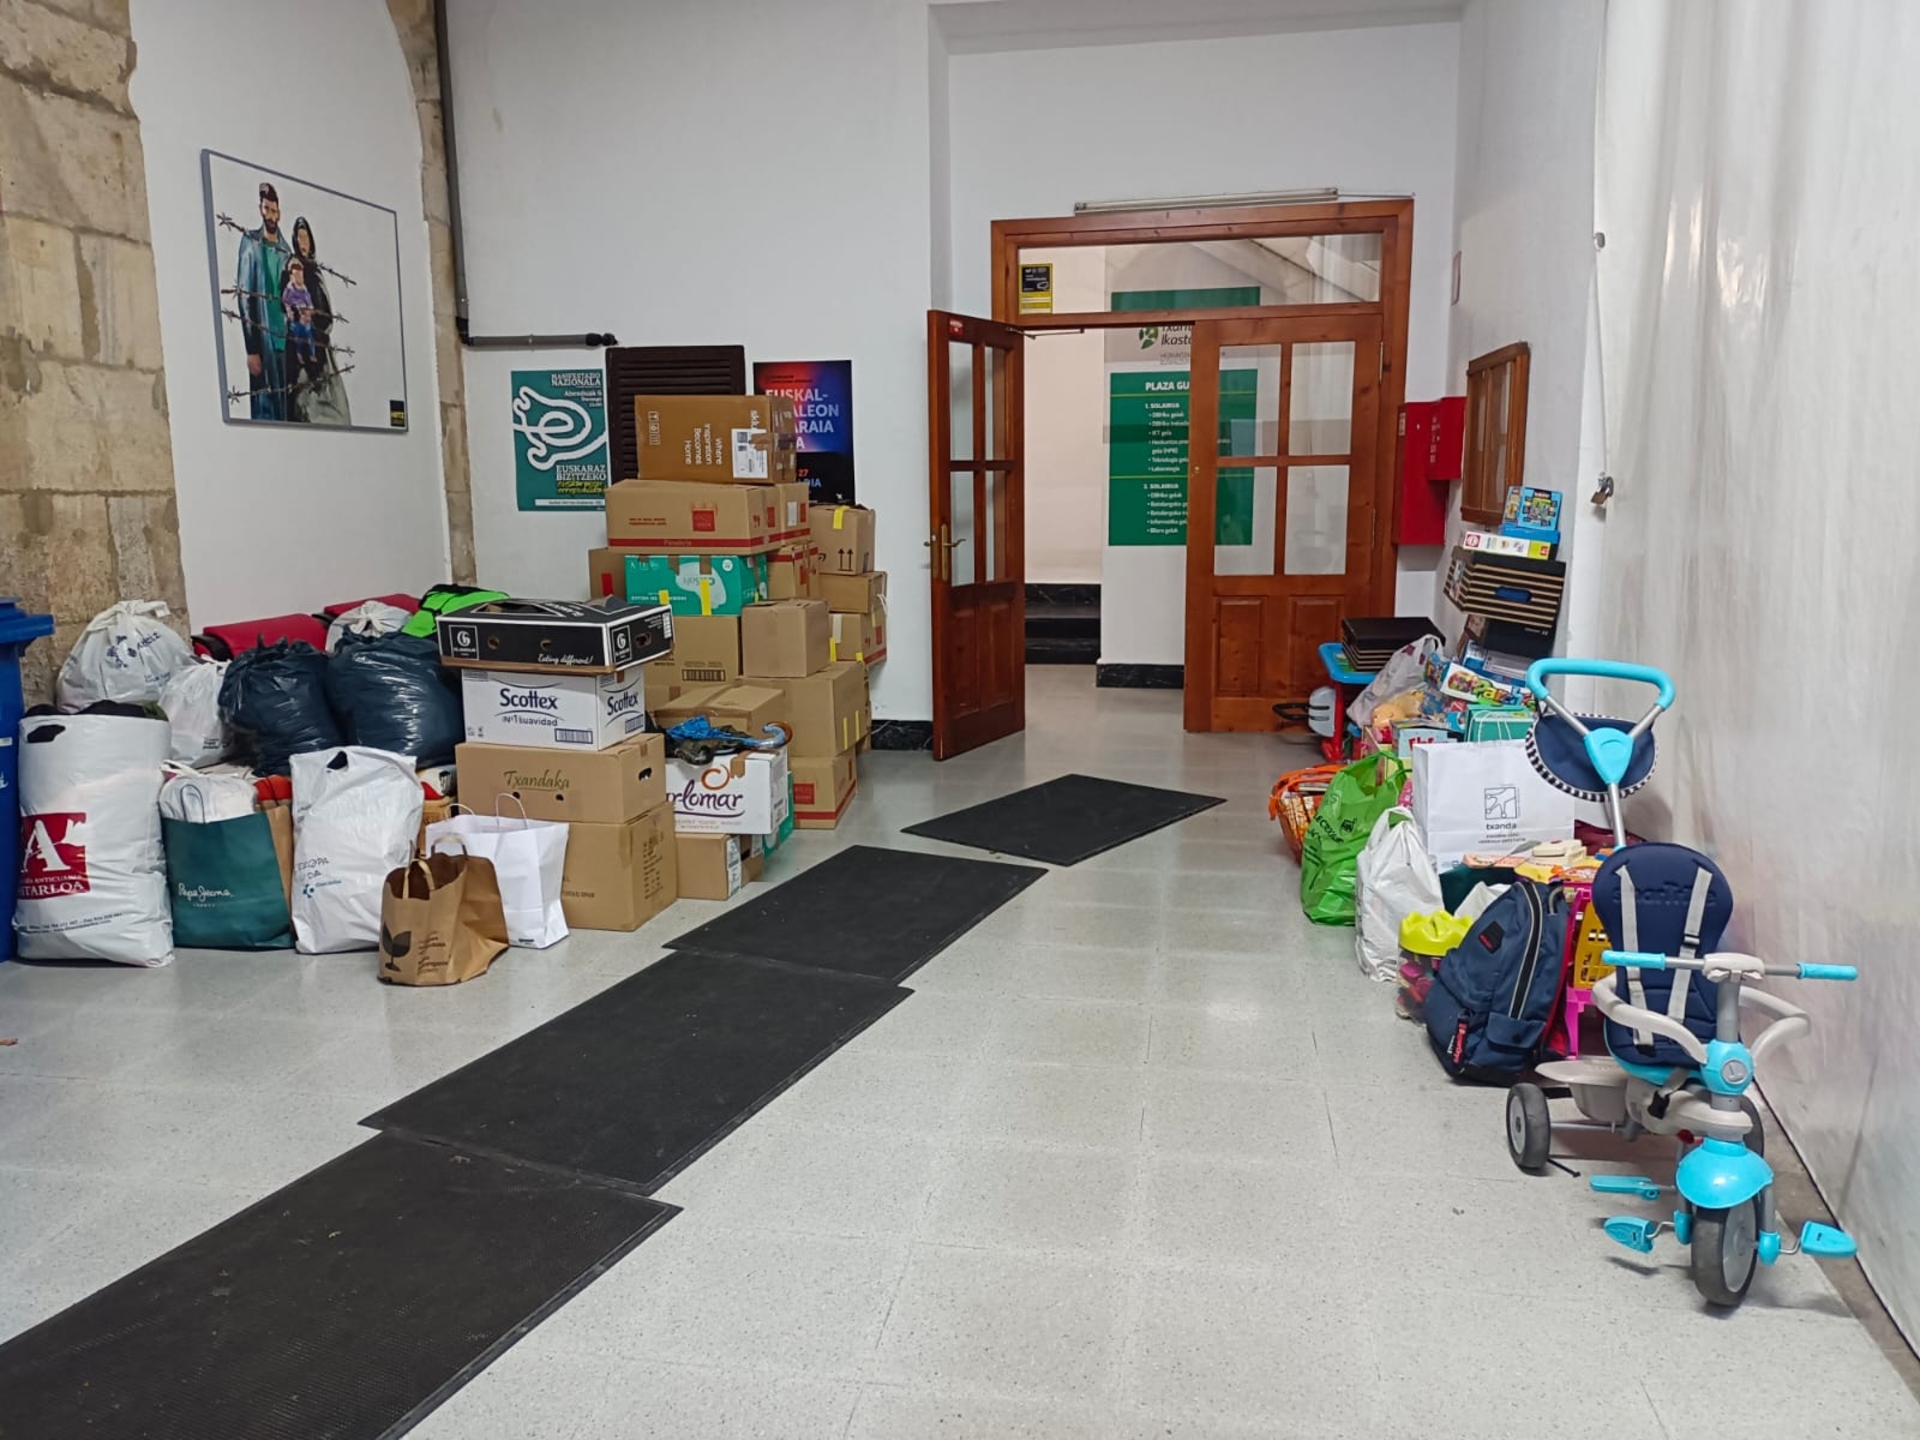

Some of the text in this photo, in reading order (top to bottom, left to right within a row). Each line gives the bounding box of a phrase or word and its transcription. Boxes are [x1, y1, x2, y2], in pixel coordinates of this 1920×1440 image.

[551, 378, 601, 386] NAZIONALA
[1145, 382, 1175, 391] PLAZA
[765, 388, 828, 402] EUSKAL-
[684, 440, 692, 465] Home
[694, 428, 702, 465] Becomes
[703, 423, 712, 465] Inspiration
[715, 437, 723, 465] Where
[556, 465, 606, 473] EUSKARAZ
[556, 473, 606, 481] BIZITZEKO
[537, 653, 560, 665] Eating
[499, 688, 558, 710] Scottex
[607, 691, 638, 716] Scottex
[518, 716, 558, 727] suavidad
[503, 769, 570, 790] Txandaka
[1486, 823, 1517, 831] txanda
[178, 882, 199, 902] Pepe
